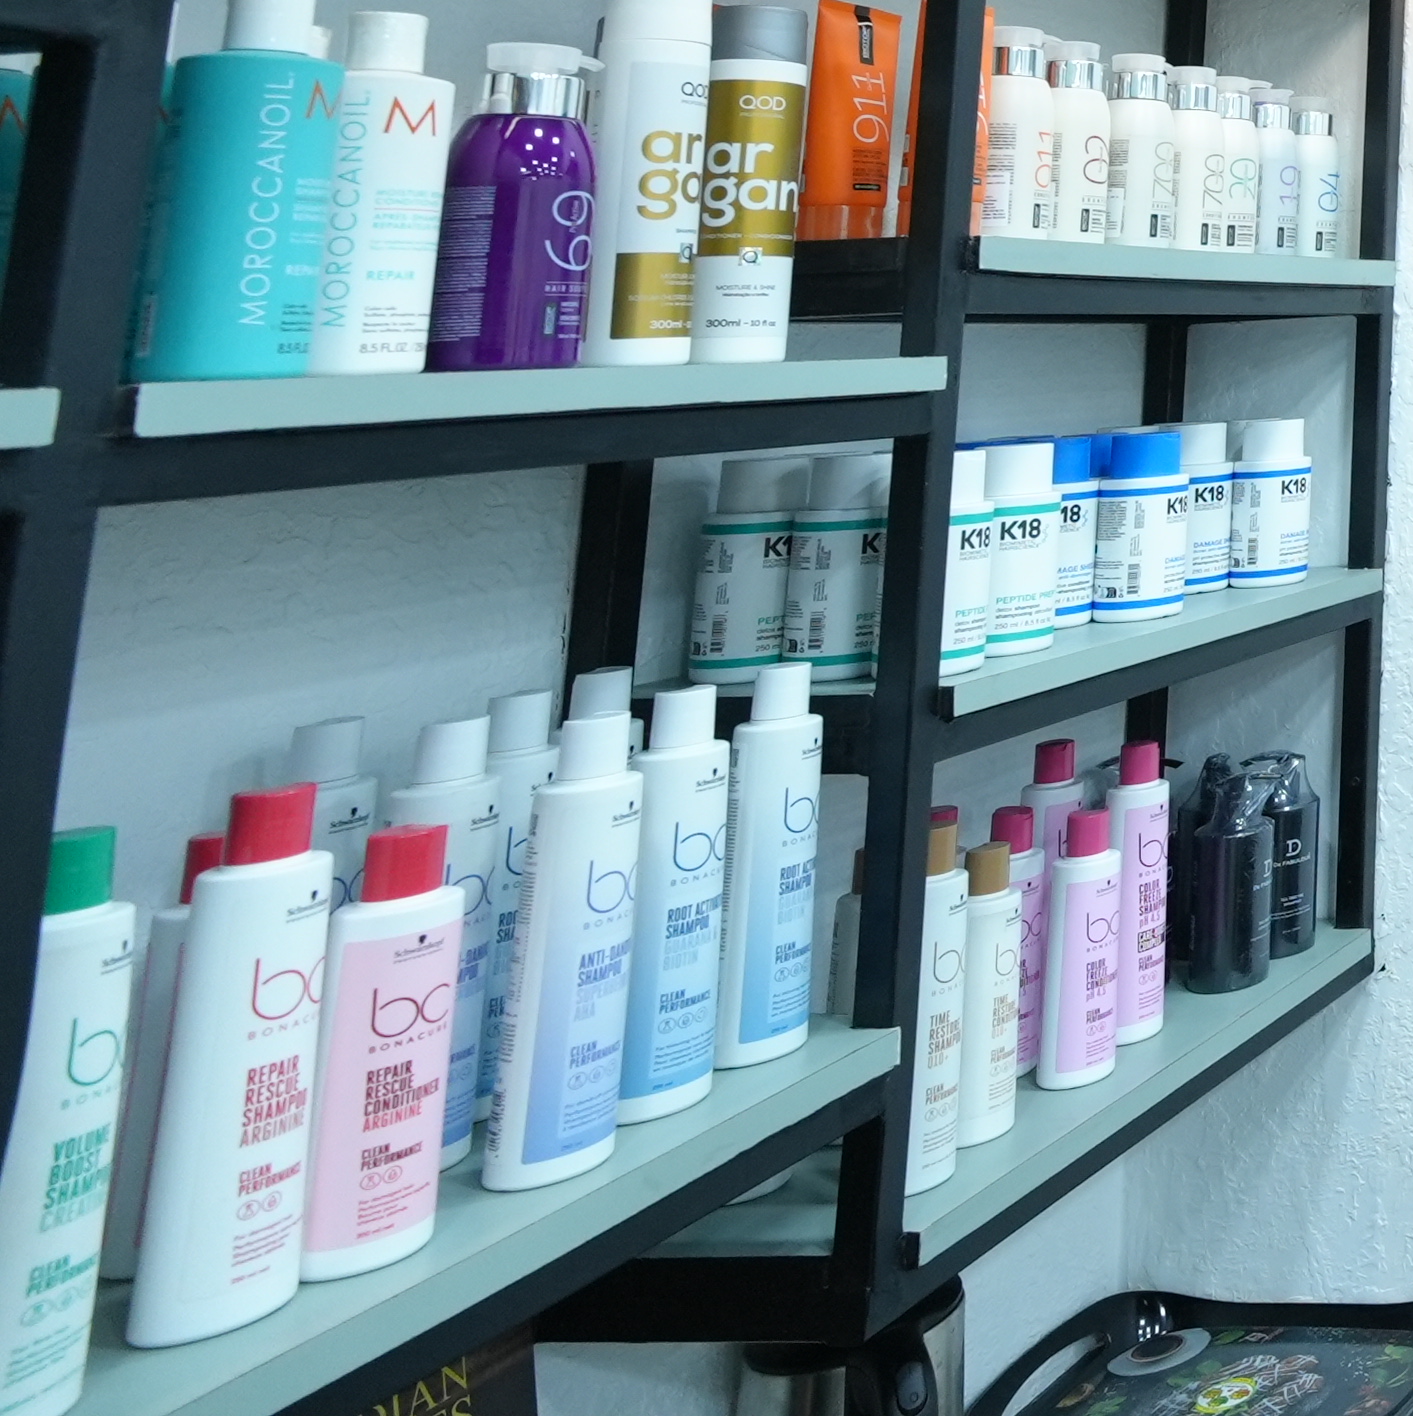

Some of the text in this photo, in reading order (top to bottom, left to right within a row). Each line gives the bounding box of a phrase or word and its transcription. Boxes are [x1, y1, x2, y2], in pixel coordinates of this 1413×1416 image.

[384, 97, 436, 136] M
[739, 95, 787, 111] QOD
[852, 72, 890, 142] 911
[706, 141, 775, 175] ar
[238, 81, 294, 325] MOROCCANOIL
[321, 97, 370, 327] MOROCCANOIL
[705, 318, 741, 328] 300ml
[1194, 484, 1225, 504] K18
[1281, 477, 1307, 495] K18
[1060, 503, 1082, 524] 18
[960, 526, 991, 550] K18
[1000, 518, 1042, 541] K18
[996, 593, 1037, 605] PEPTIDE
[665, 914, 711, 940] SHAMPOO
[371, 982, 450, 1038] bc
[930, 1010, 951, 1029] TIME
[246, 1054, 300, 1088] REPAIR
[366, 1059, 414, 1086] REPAIR
[244, 1072, 301, 1109] RESCUE
[365, 1073, 415, 1102] RESCUE
[242, 1088, 308, 1129] SHAMPOO
[362, 1099, 423, 1134] ARGININE
[238, 1106, 306, 1149] ARGININE
[361, 1142, 391, 1161] CLEAN
[239, 1162, 273, 1185] CLEAN
